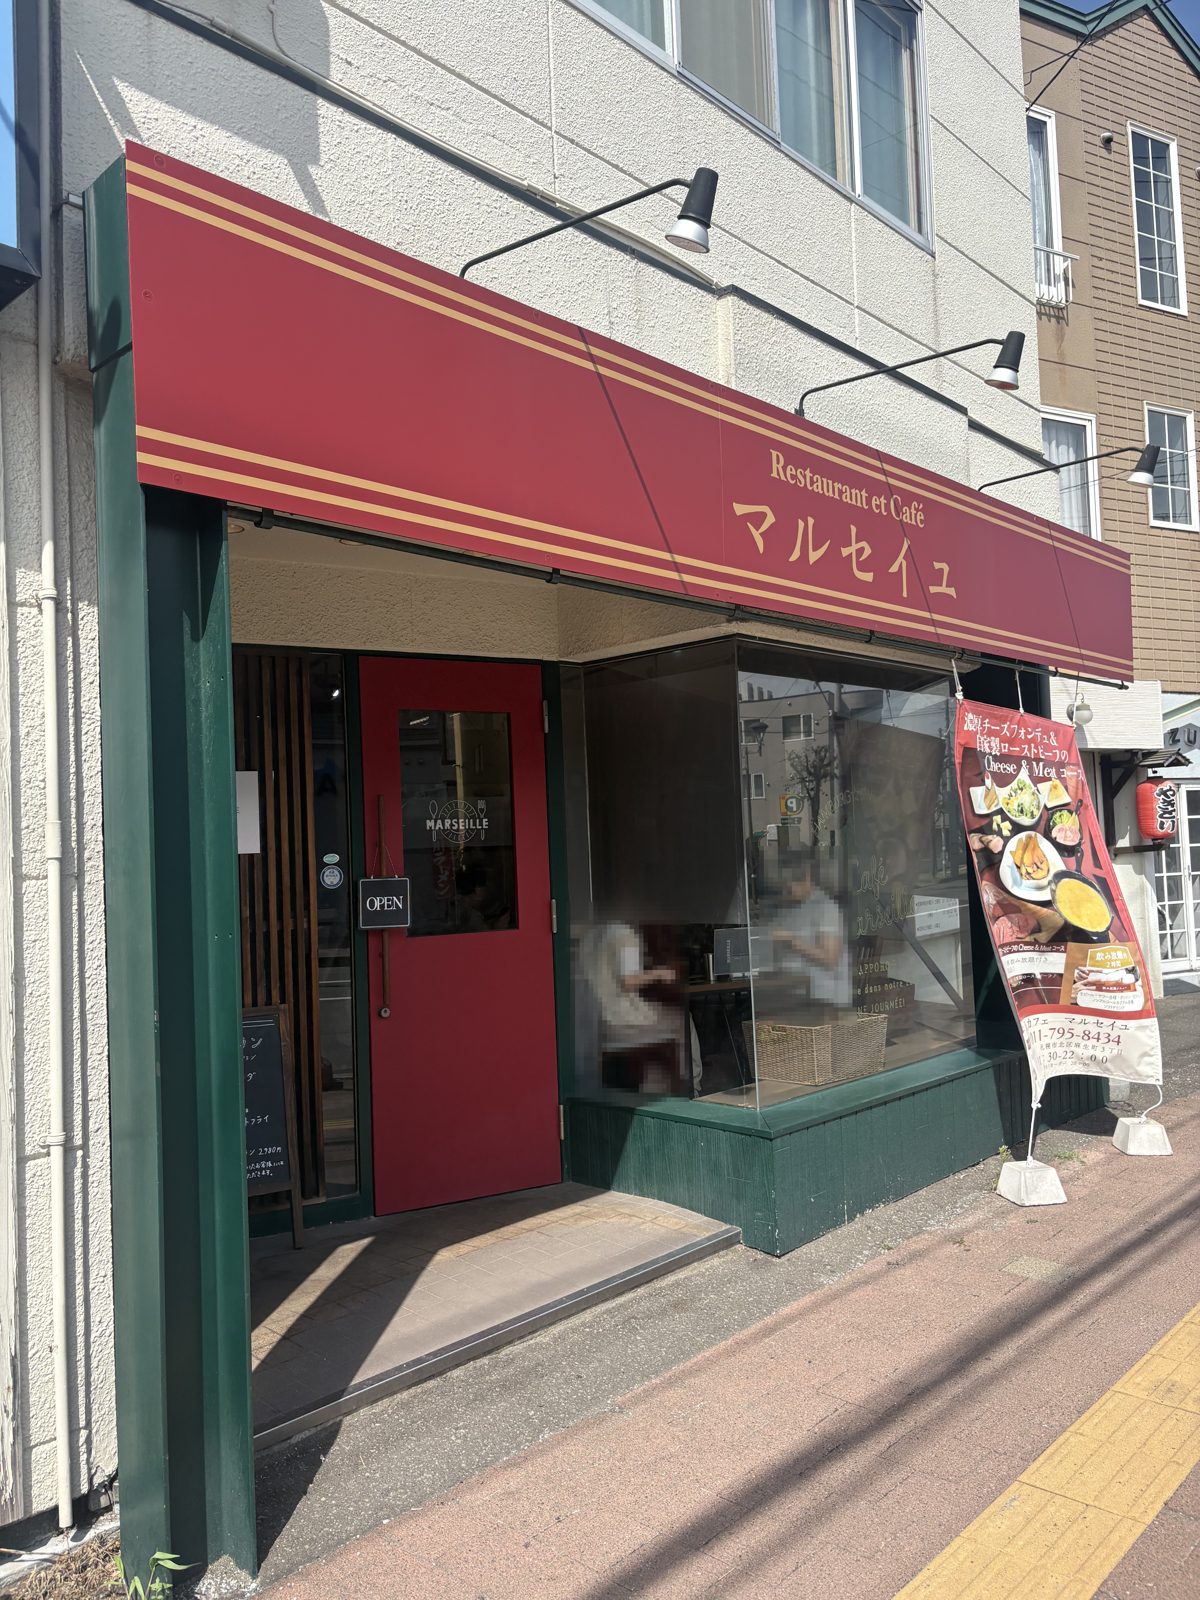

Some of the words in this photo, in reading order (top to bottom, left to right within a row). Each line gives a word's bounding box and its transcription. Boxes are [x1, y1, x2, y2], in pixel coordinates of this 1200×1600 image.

[769, 449, 869, 510] Restaurant
[872, 494, 887, 516] et
[890, 494, 925, 528] Café
[732, 502, 957, 599] マルセイユ
[985, 754, 1018, 775] Cheese
[1032, 761, 1058, 778] Meat
[426, 818, 489, 831] MARSEILLE
[366, 895, 403, 911] OPEN
[858, 961, 889, 977] APPORO
[1064, 1017, 1130, 1031] マルセイユ
